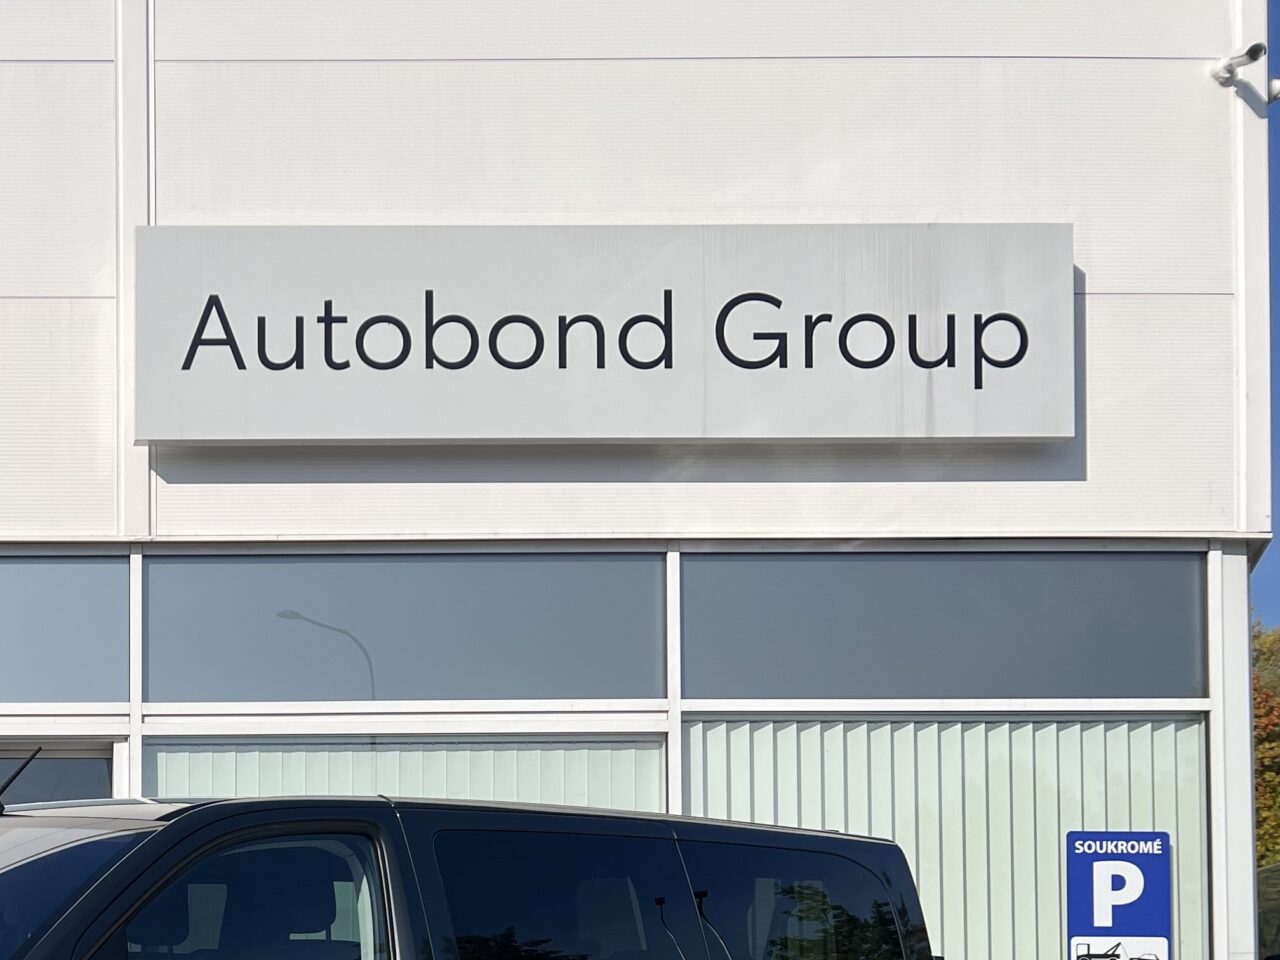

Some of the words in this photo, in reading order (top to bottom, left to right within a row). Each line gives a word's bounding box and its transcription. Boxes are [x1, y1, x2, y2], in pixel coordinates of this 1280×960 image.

[181, 289, 674, 371] Autobond
[716, 291, 1030, 389] Group
[1074, 838, 1163, 855] SOUKROMÉ
[1092, 860, 1145, 928] P
